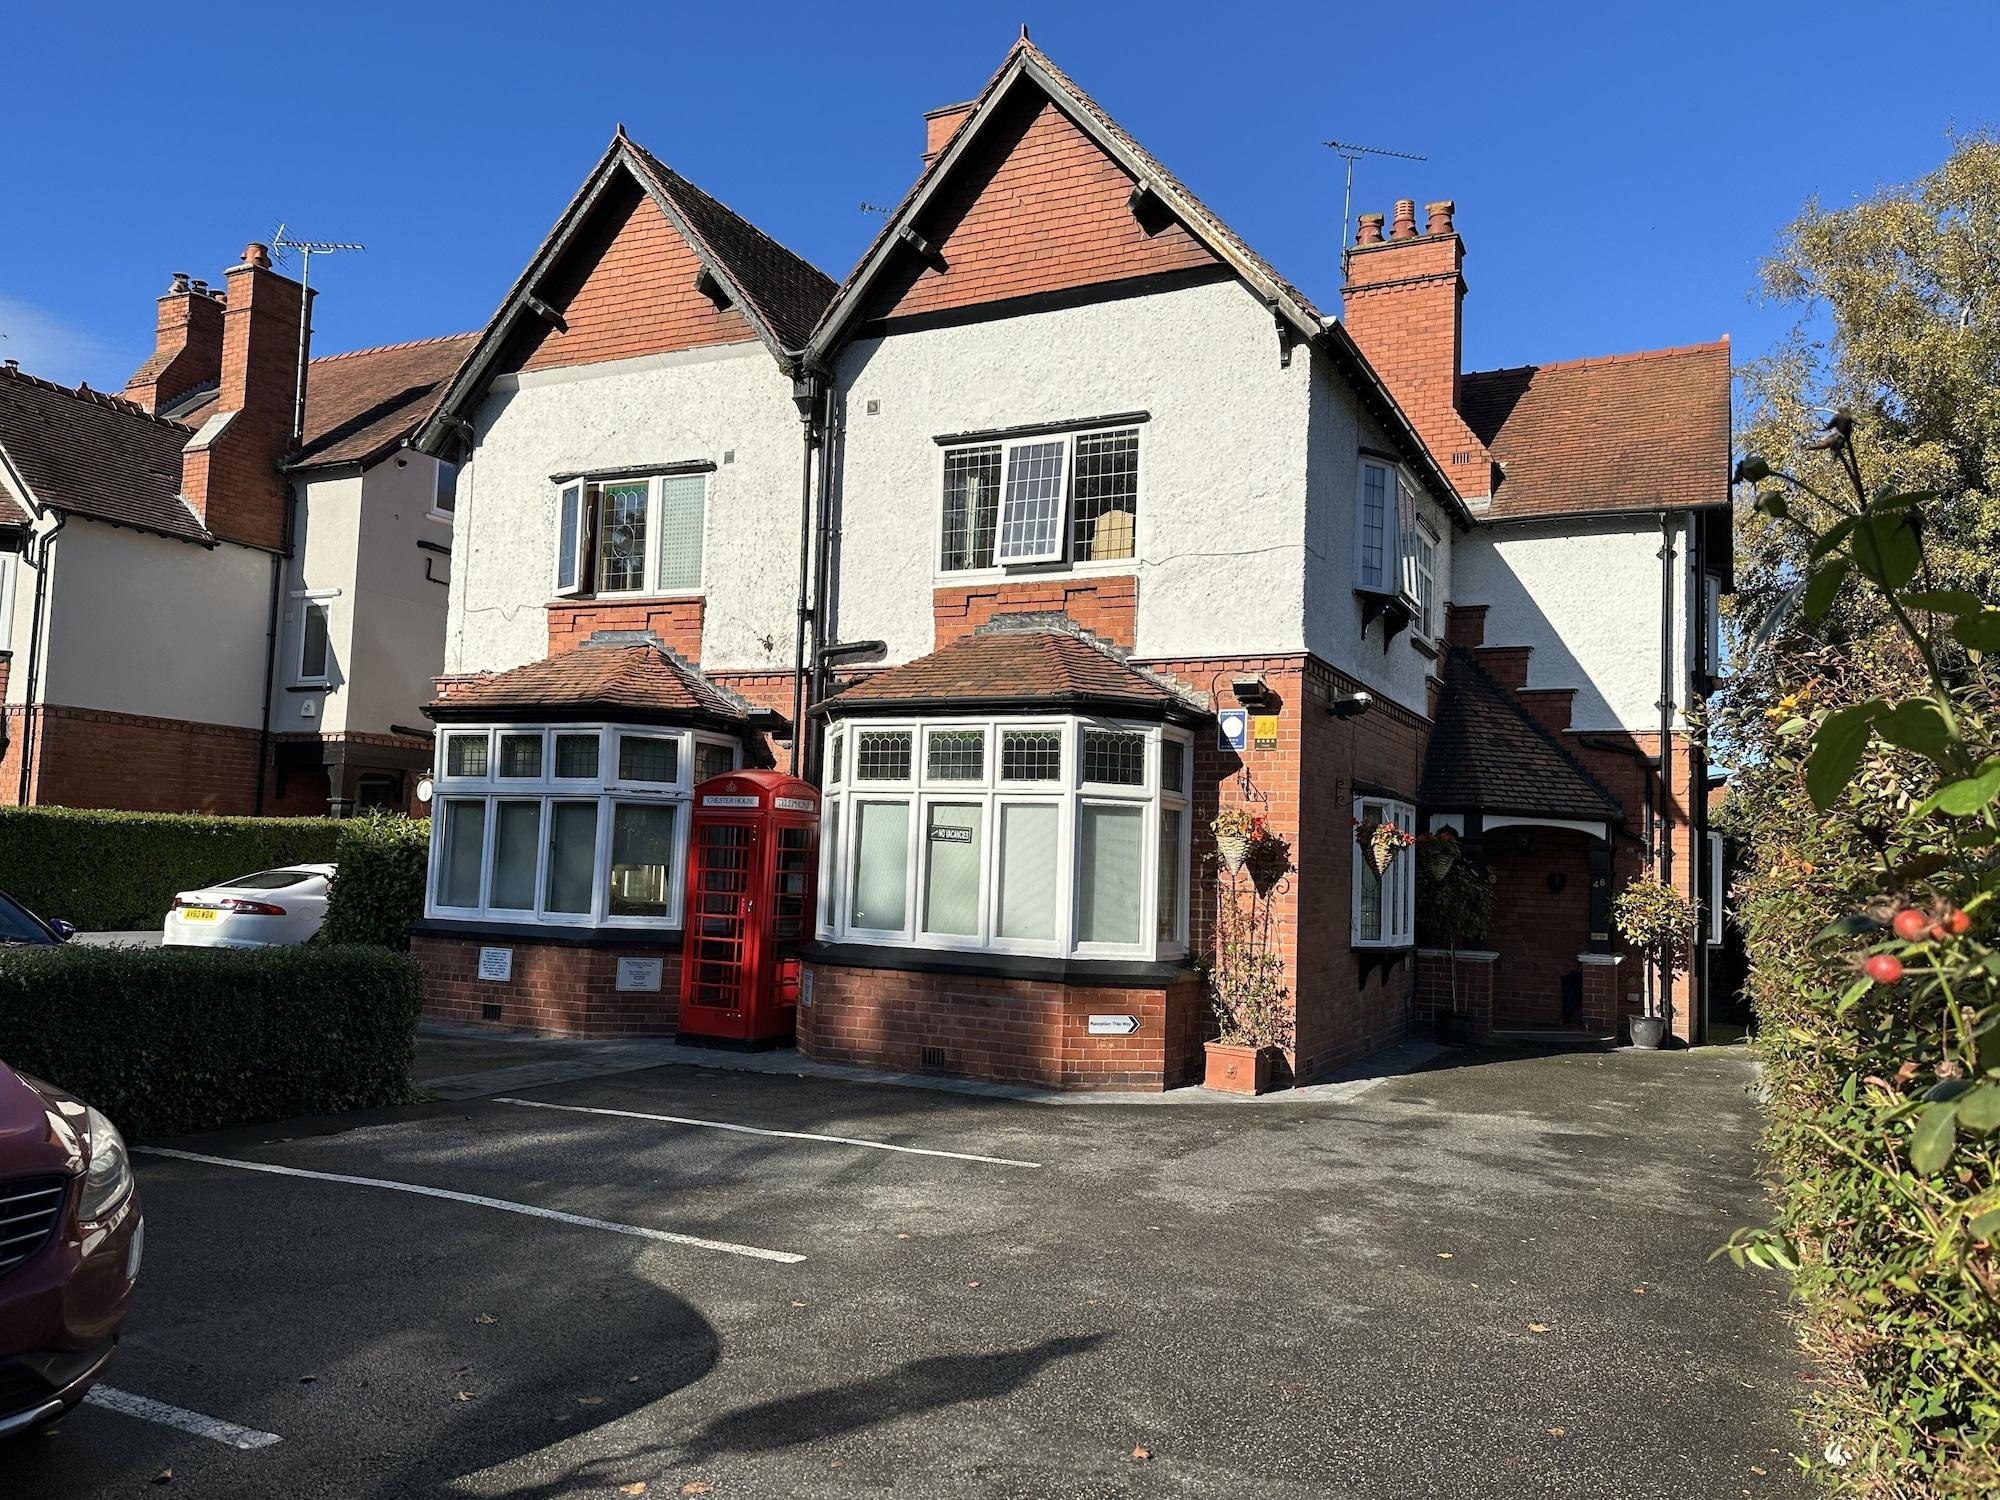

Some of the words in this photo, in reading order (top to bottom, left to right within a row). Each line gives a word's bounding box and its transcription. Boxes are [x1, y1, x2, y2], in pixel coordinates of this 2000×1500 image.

[1257, 721, 1275, 735] AA
[778, 799, 811, 809] TELEPHONE
[938, 828, 945, 838] NO
[945, 829, 969, 840] VACANCIES
[1592, 878, 1606, 888] 46
